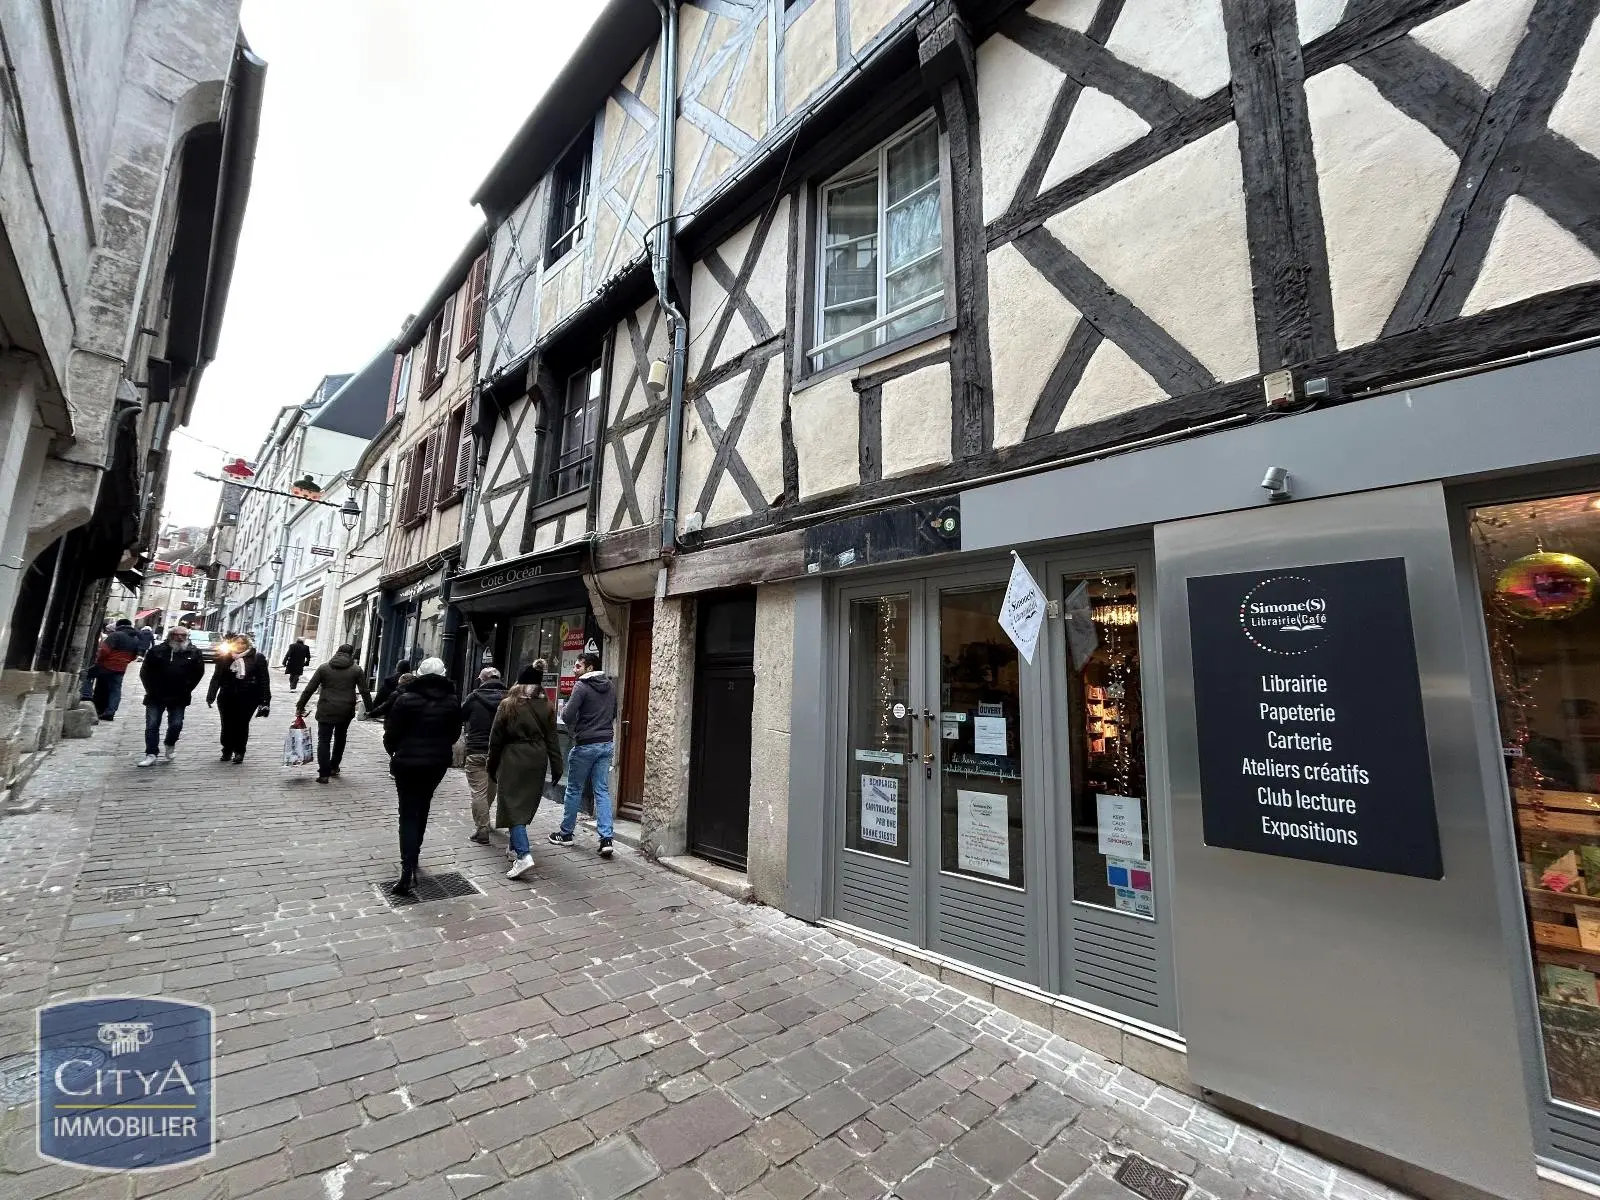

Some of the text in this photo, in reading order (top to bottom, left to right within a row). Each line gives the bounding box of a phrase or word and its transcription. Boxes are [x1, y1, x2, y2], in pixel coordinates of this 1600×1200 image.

[506, 565, 542, 581] Océan
[1250, 598, 1326, 615] Simone(S)
[1262, 674, 1328, 693] Librairie
[980, 706, 1001, 715] OUVERT
[1260, 703, 1336, 725] Papeterie
[1267, 731, 1333, 752] Carterie
[1242, 757, 1370, 785] Ateliers créatifs
[1257, 786, 1357, 815] Club lecture
[1262, 816, 1358, 846] Expositions
